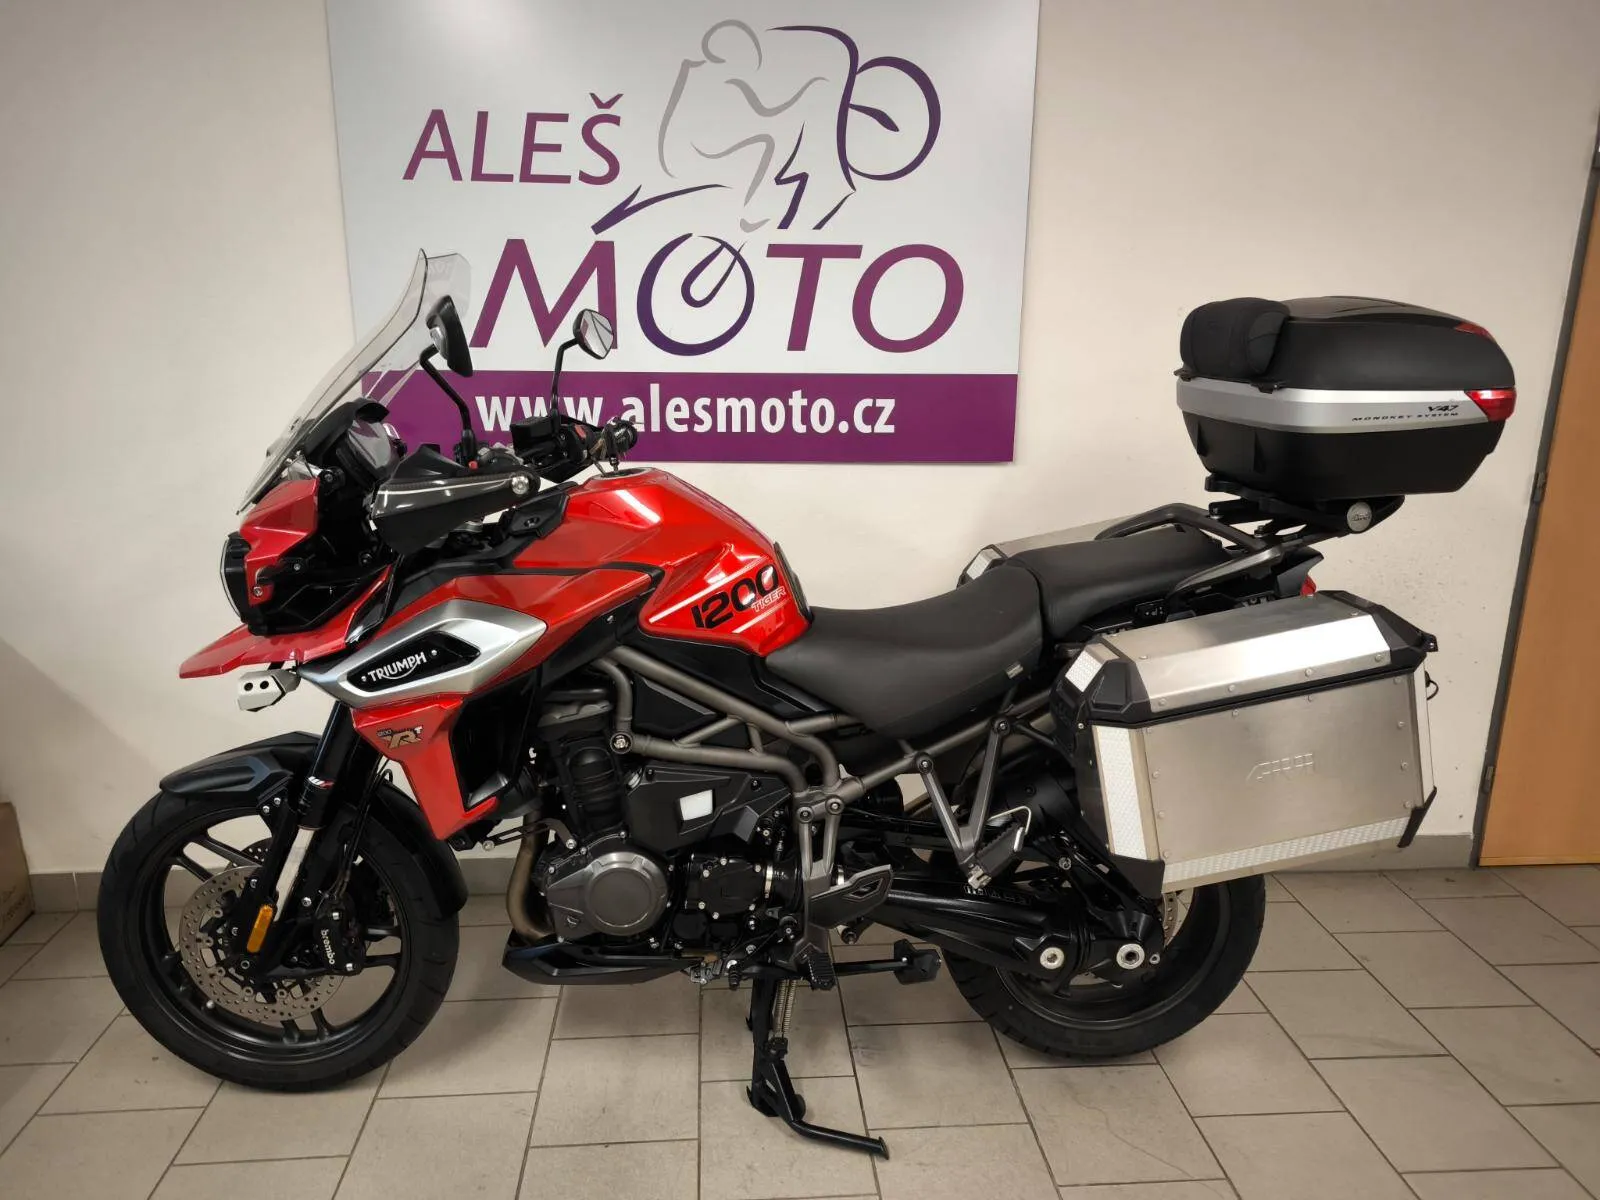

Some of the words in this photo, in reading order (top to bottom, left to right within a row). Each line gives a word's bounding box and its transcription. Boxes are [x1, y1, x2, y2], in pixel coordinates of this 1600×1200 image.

[403, 92, 624, 186] ALEŠ
[469, 233, 964, 356] MOTO
[475, 383, 896, 434] wwalesmoto.cz
[690, 564, 779, 629] 1200
[751, 585, 787, 613] TIGER
[367, 651, 428, 682] TRIUMPH
[320, 928, 336, 965] brembo
